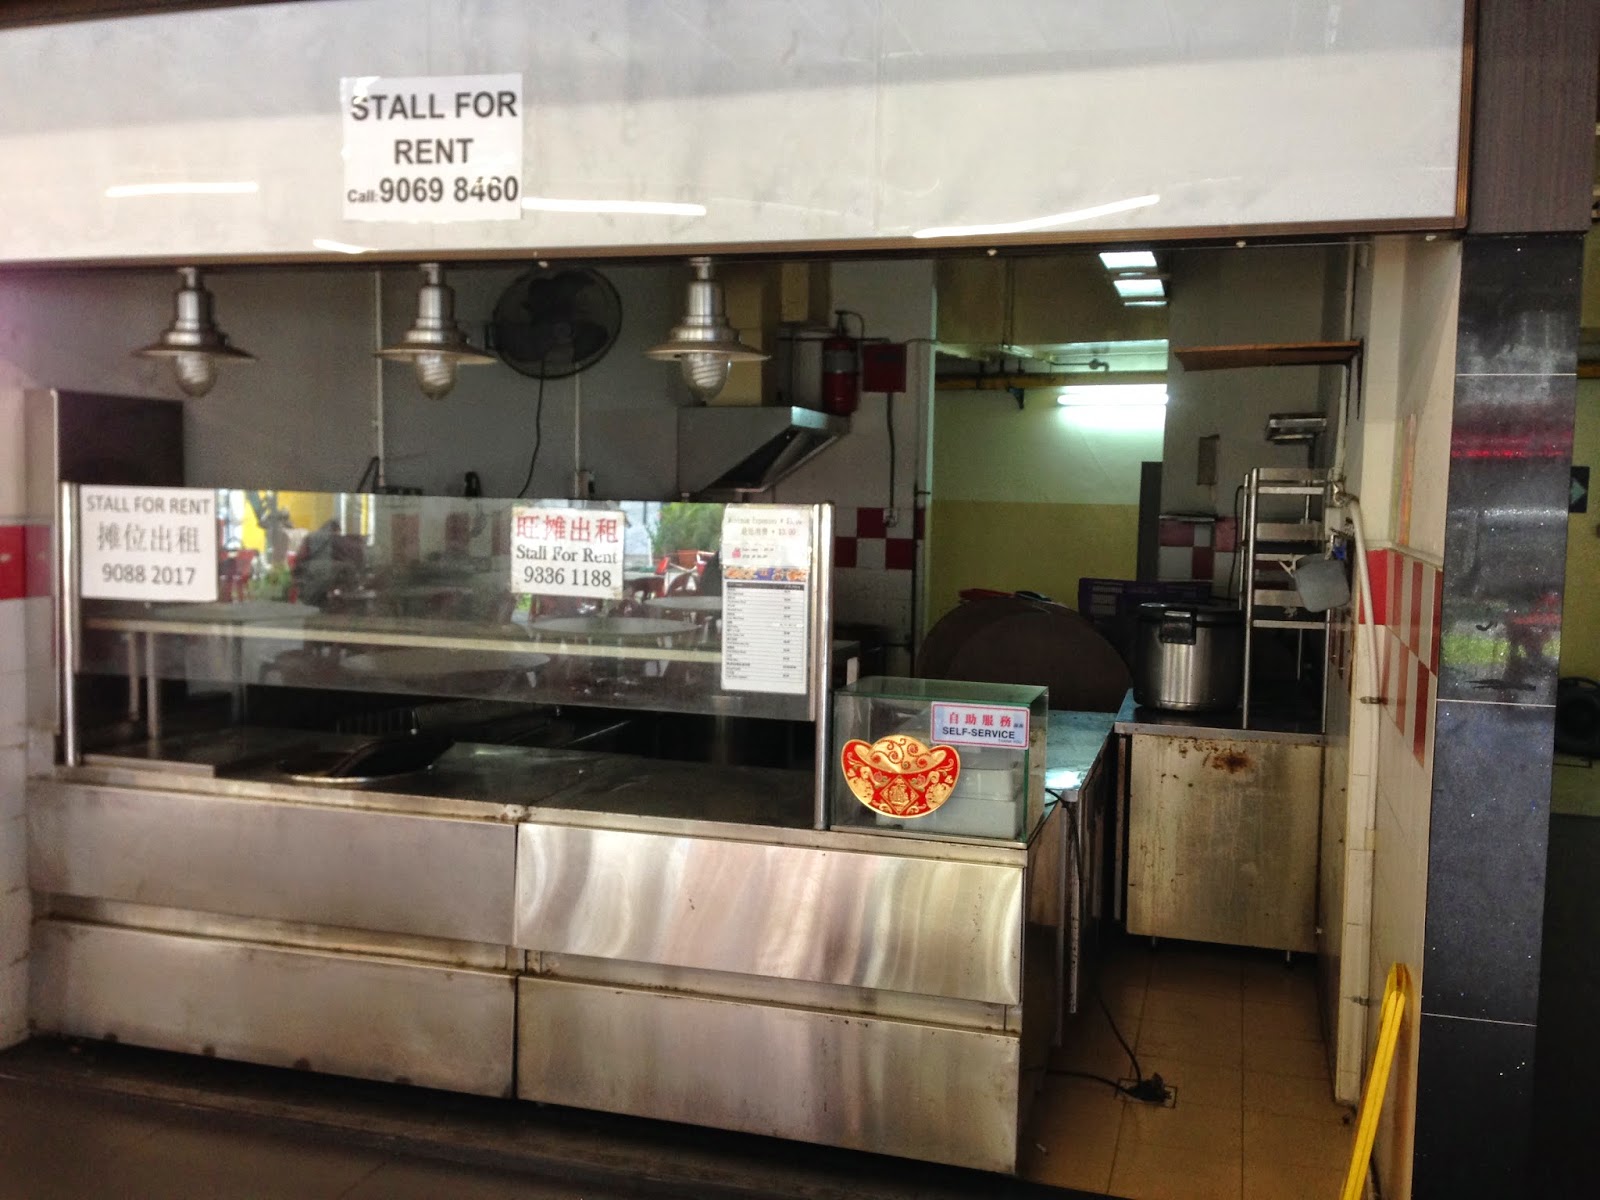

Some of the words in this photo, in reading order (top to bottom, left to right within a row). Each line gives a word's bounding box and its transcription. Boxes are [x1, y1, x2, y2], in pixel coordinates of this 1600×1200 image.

[351, 93, 445, 121] STALL
[455, 90, 518, 118] FOR
[394, 138, 474, 165] RENT
[379, 177, 444, 203] 9069
[453, 175, 519, 203] 8460
[87, 495, 129, 512] STALL
[134, 496, 165, 513] FOR
[170, 498, 210, 514] RENT
[516, 544, 547, 561] Stall
[552, 545, 579, 562] For
[582, 547, 618, 565] Rent
[102, 562, 147, 583] 9088
[151, 565, 197, 586] 2017
[524, 565, 565, 585] 9336
[572, 568, 612, 588] 1188
[942, 727, 1015, 739] SELF-SERVICE
